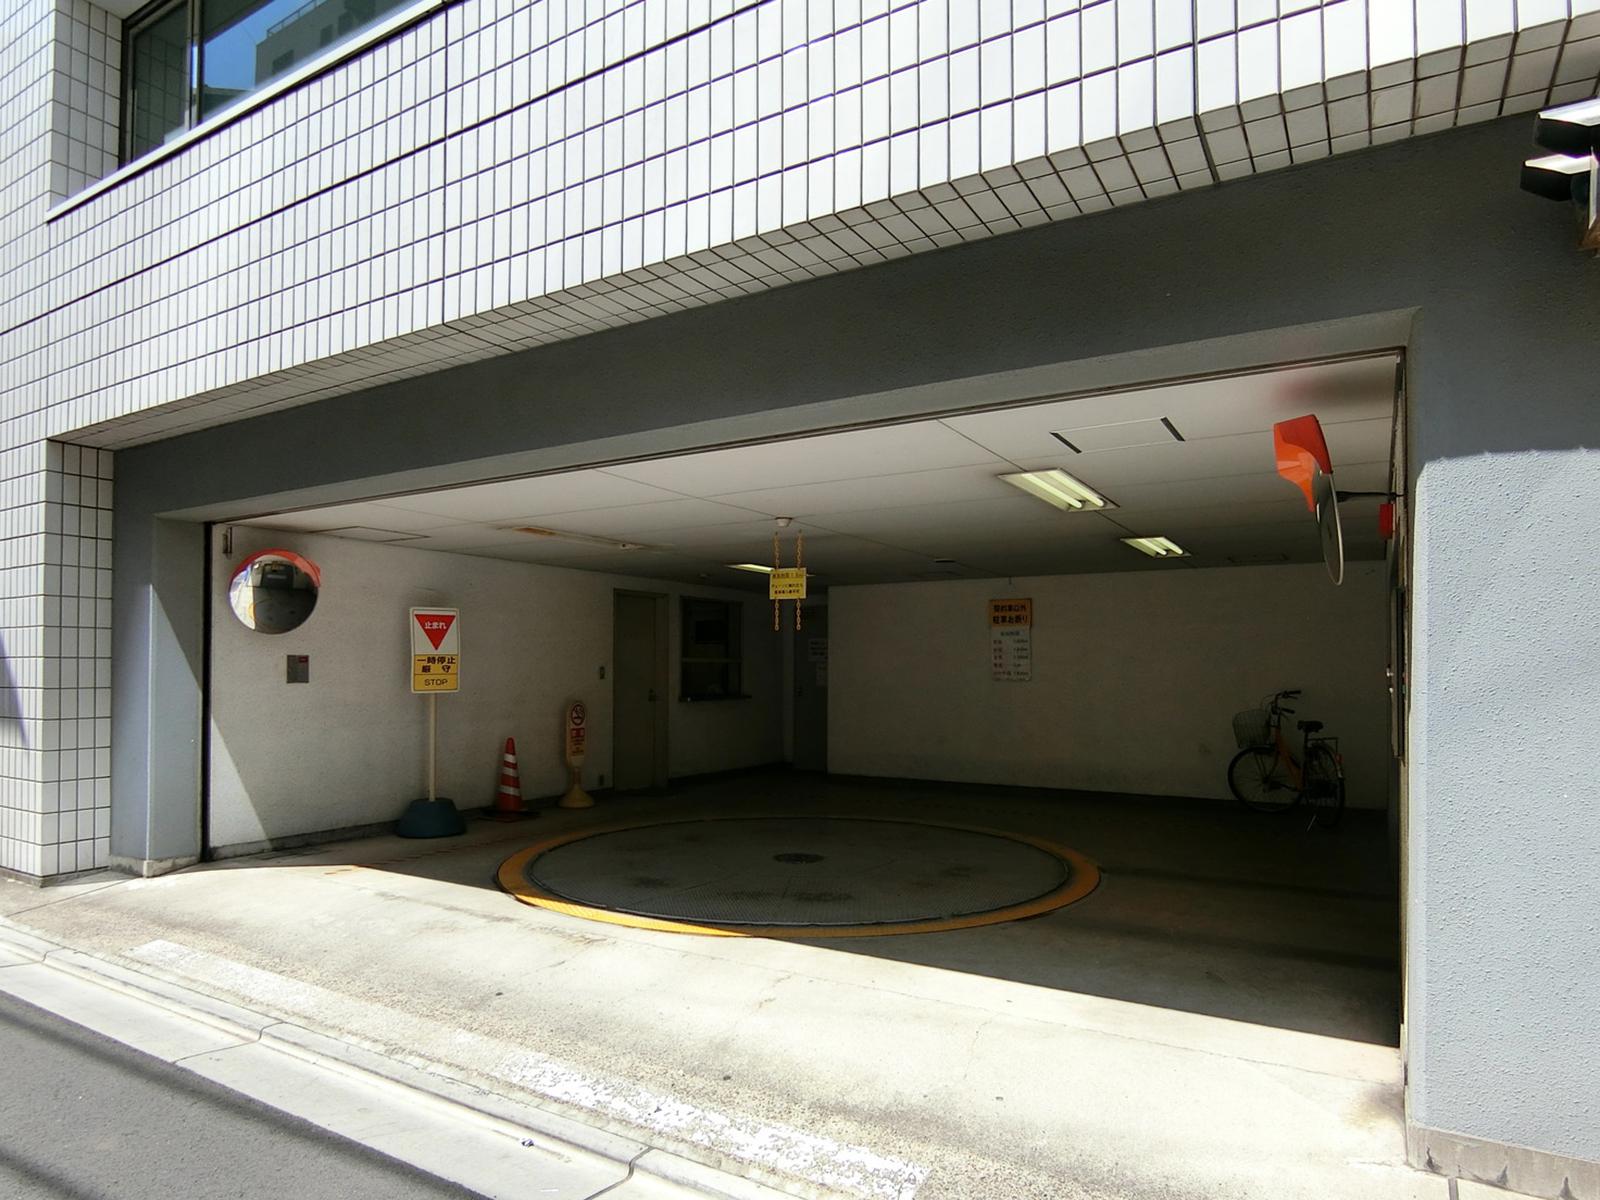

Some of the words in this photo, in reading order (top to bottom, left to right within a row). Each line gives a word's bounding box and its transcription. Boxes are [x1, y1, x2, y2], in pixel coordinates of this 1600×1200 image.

[993, 604, 1027, 613] 契約車以外
[992, 615, 1028, 624] 駐車お断り
[424, 621, 447, 630] 止まれ
[417, 656, 456, 664] 一時停止
[424, 678, 448, 686] STOP
